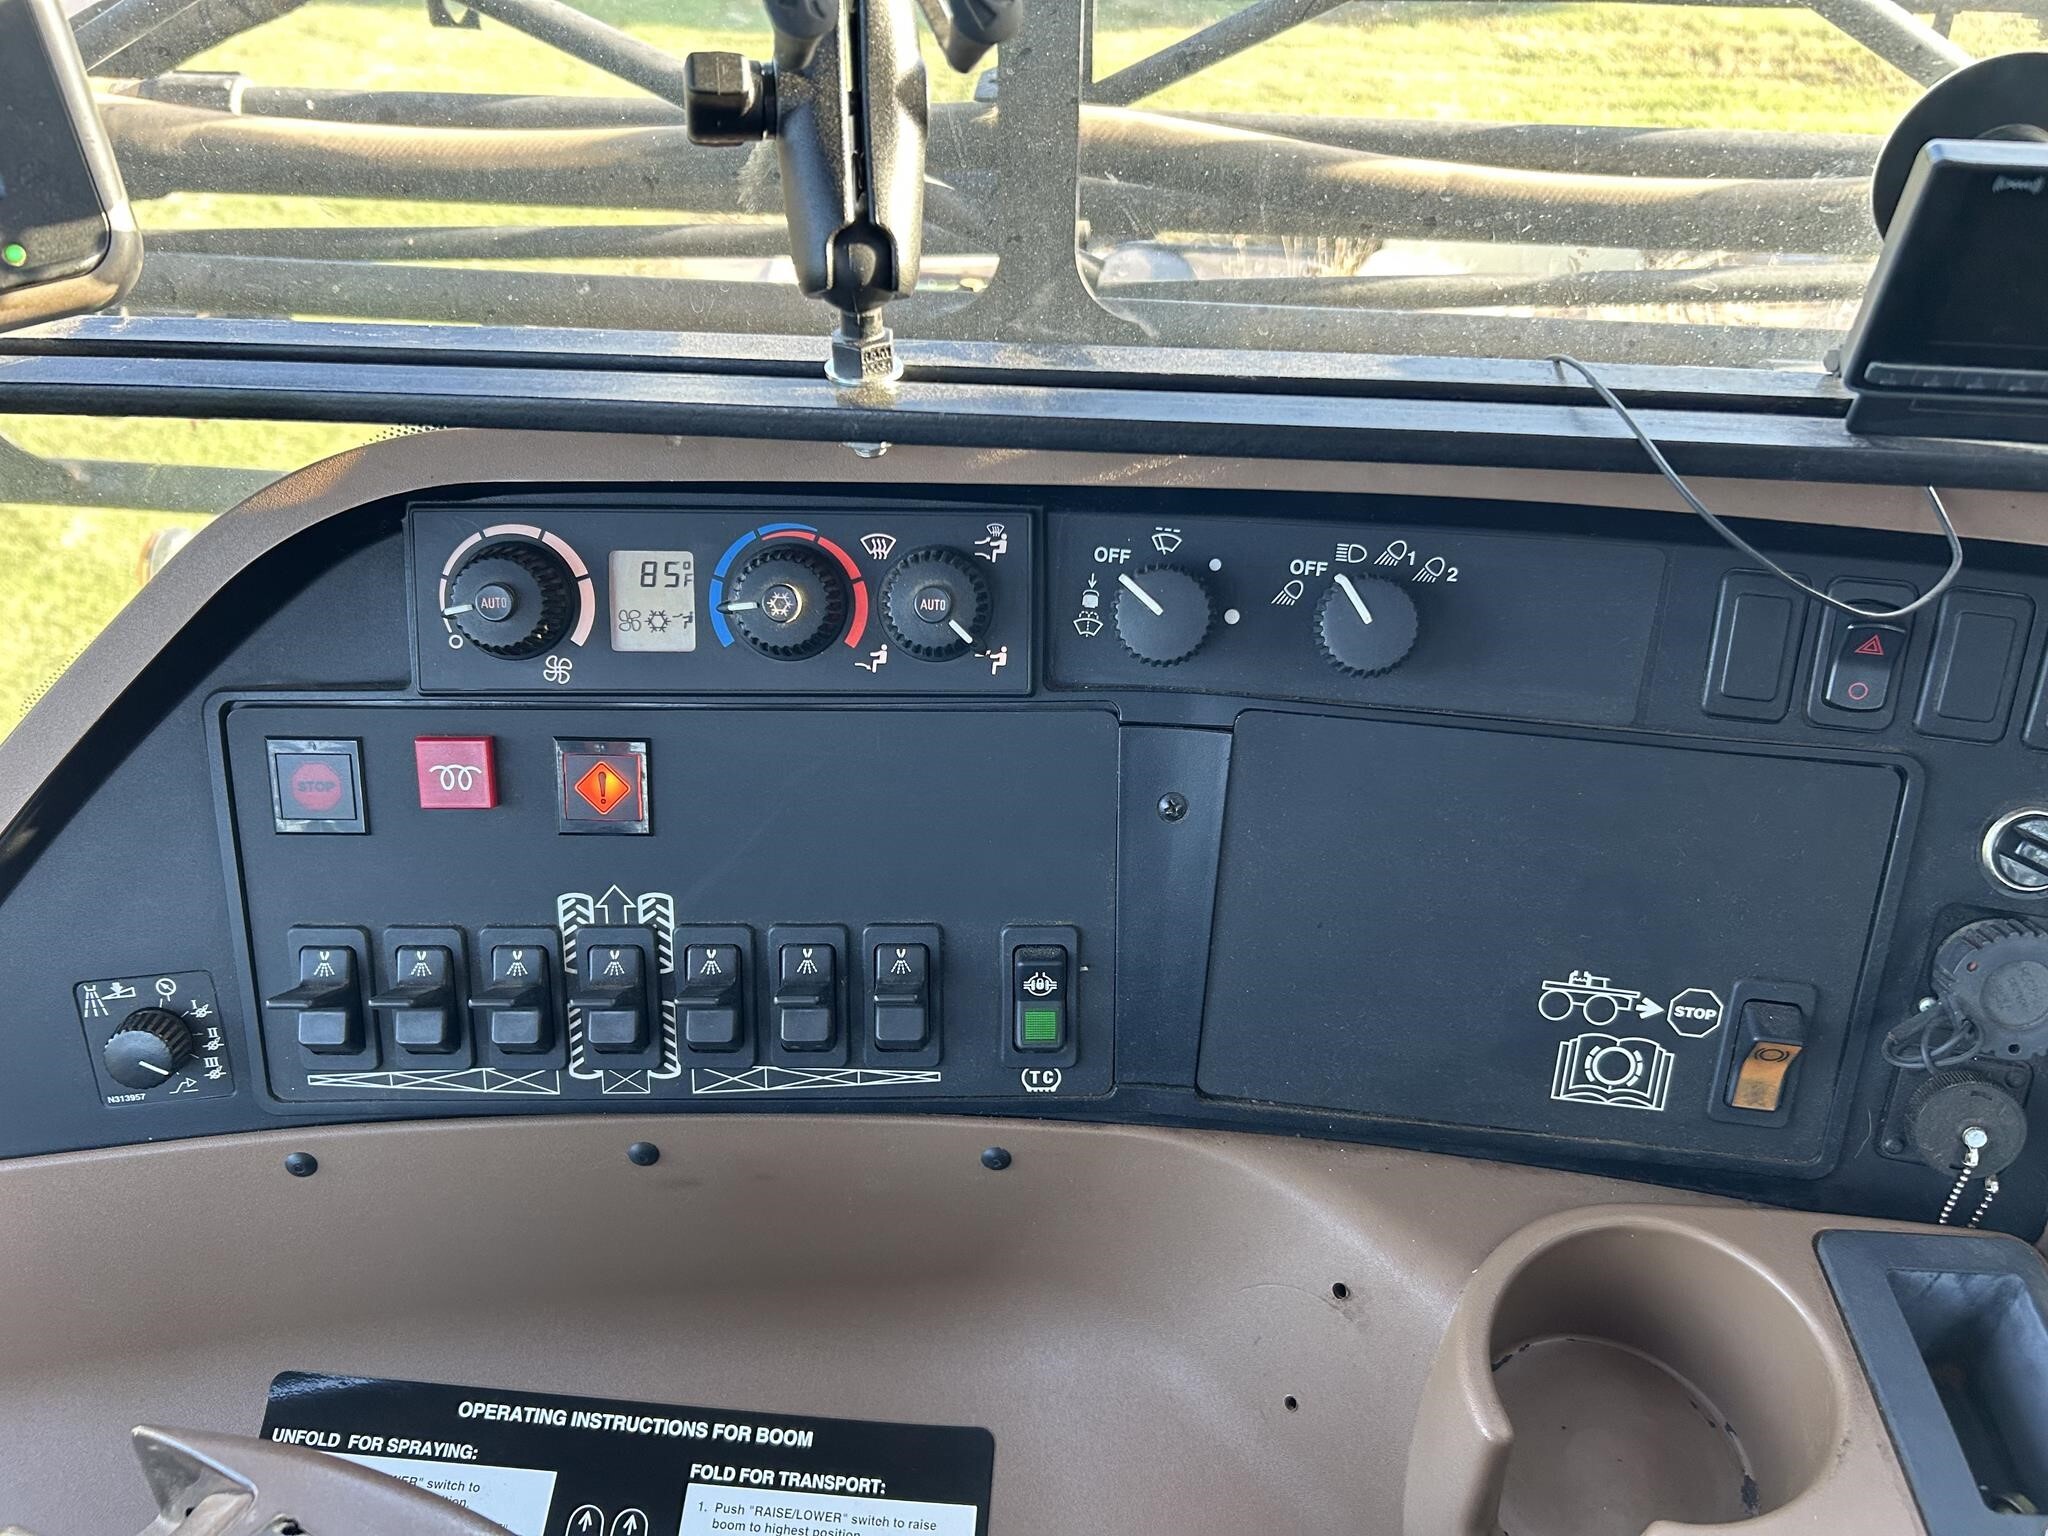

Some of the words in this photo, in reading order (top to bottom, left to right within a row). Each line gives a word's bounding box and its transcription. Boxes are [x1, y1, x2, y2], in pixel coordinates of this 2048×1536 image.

[1093, 546, 1131, 565] OFF
[1407, 550, 1416, 566] 1
[1289, 559, 1329, 577] OFF
[1446, 566, 1459, 582] 2
[480, 597, 507, 609] AUTO
[920, 598, 946, 611] AUTO
[297, 780, 337, 793] STOP
[1673, 1005, 1717, 1020] STOP
[106, 1093, 146, 1104] N313957
[458, 1401, 567, 1426] OPERATING
[570, 1411, 708, 1439] INSTRUCTIONS
[711, 1423, 753, 1442] FOR
[755, 1427, 814, 1448] BOOM
[272, 1427, 341, 1448] UNFOLD
[347, 1434, 384, 1452] FOR
[386, 1437, 479, 1460] SPRAYING:
[426, 1479, 465, 1492] switch
[468, 1482, 480, 1493] to
[689, 1463, 737, 1482] FOLD
[739, 1467, 775, 1485] FOR
[778, 1471, 886, 1494] TRANSPORT:
[698, 1501, 708, 1513] 1.
[714, 1502, 745, 1515] Push
[750, 1505, 848, 1523] "RAISE/LOWER"
[851, 1515, 890, 1528] switch
[893, 1517, 905, 1529] to
[908, 1520, 937, 1531] raise
[712, 1518, 746, 1532] boom
[749, 1522, 761, 1533] to
[764, 1522, 809, 1536] highest
